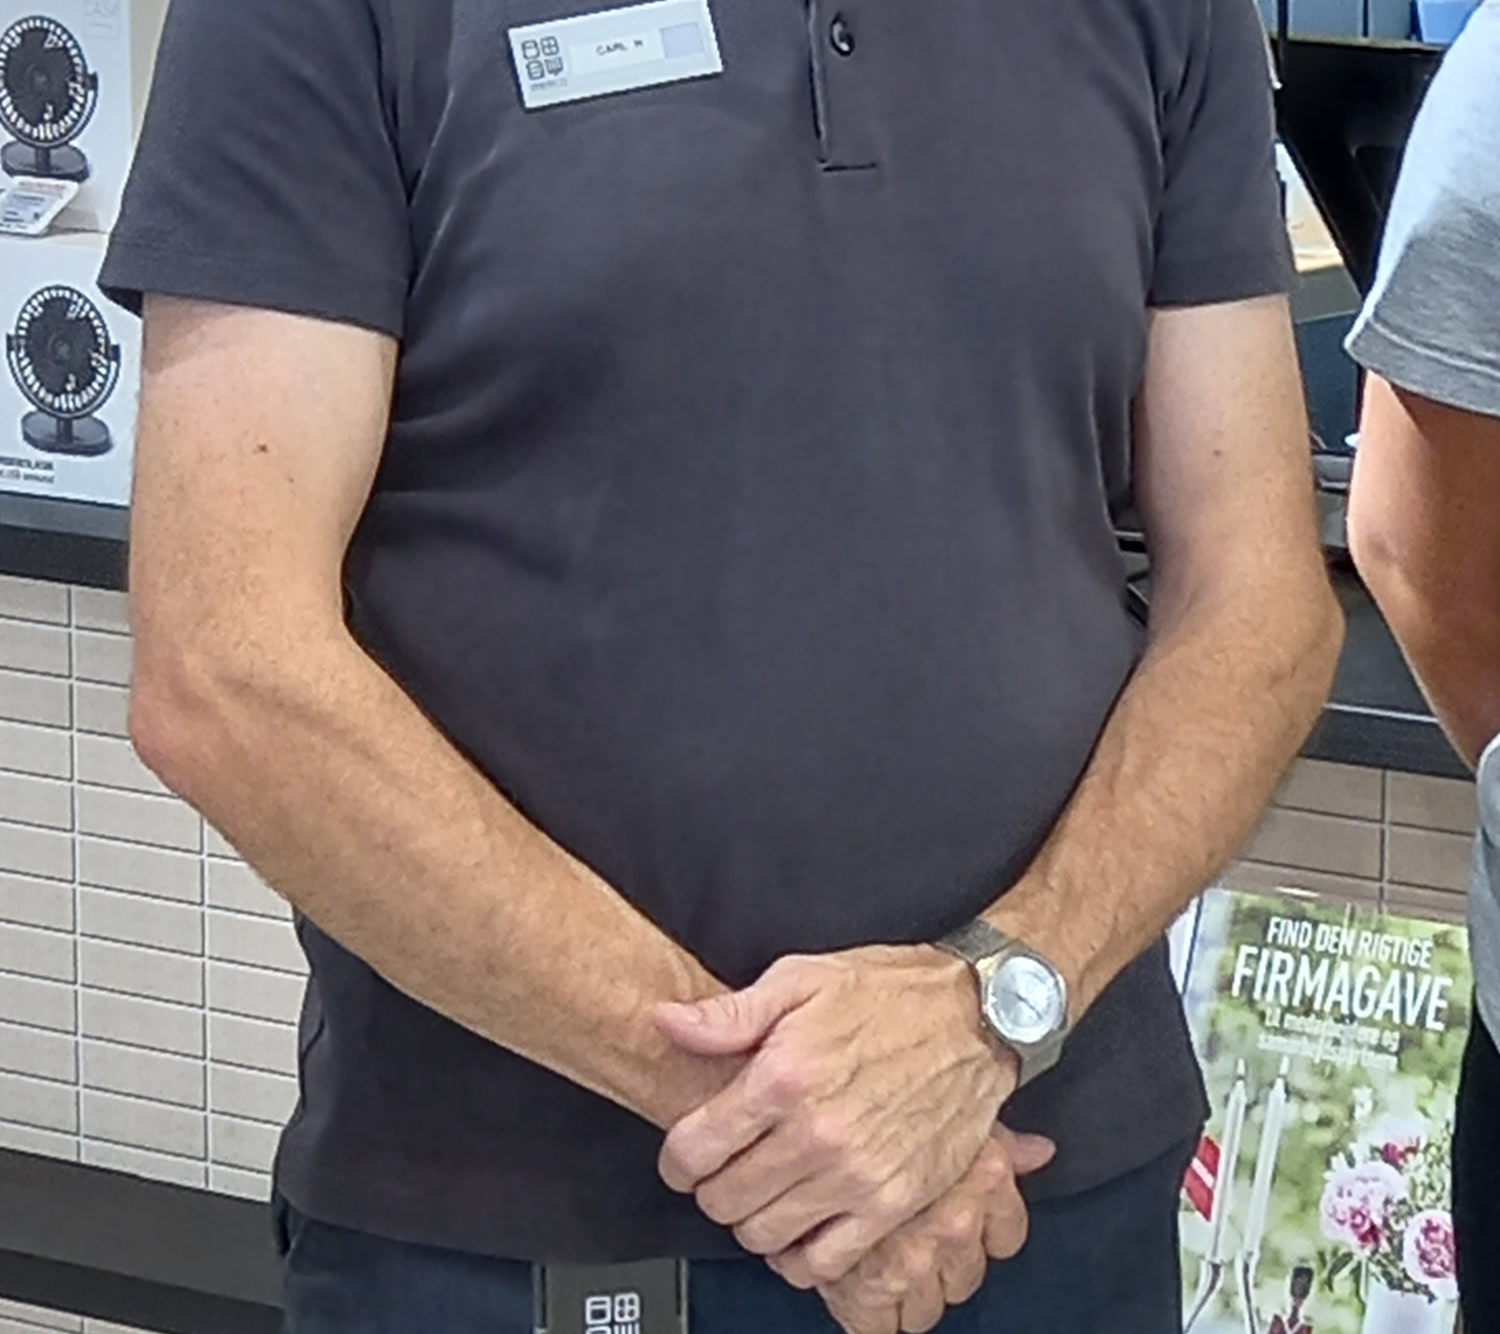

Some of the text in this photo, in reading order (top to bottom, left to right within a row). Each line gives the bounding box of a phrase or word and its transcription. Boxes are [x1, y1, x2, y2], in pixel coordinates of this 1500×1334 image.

[1267, 916, 1433, 968] FIND DEN RIGTIGE
[1231, 944, 1453, 1031] FIRMAGAVE
